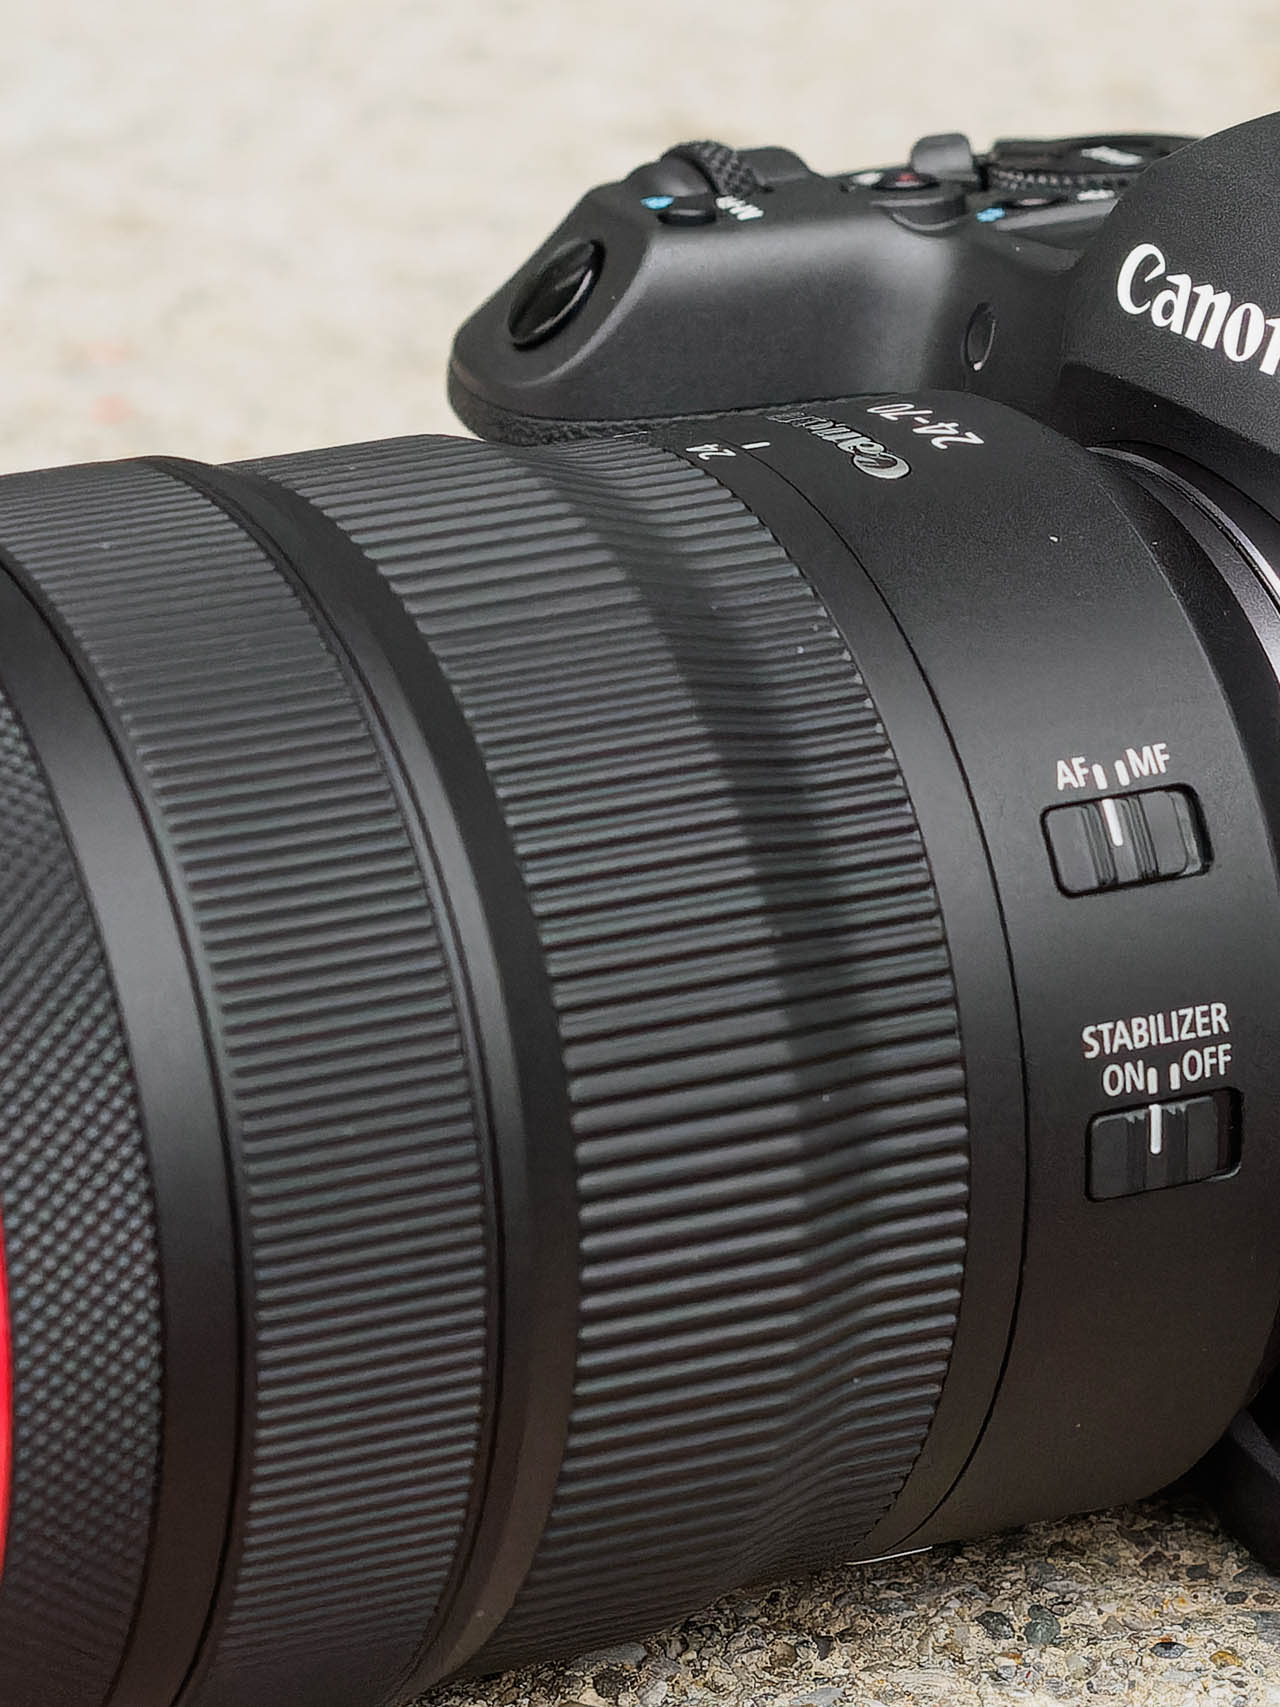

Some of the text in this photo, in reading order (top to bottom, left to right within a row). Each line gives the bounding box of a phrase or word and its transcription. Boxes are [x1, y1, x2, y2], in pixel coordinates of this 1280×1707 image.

[867, 403, 984, 449] 24-70
[685, 443, 737, 460] 24
[1056, 743, 1171, 790] AF MF
[1081, 1002, 1230, 1059] STABILIZER
[1103, 1043, 1232, 1096] ON OFF
